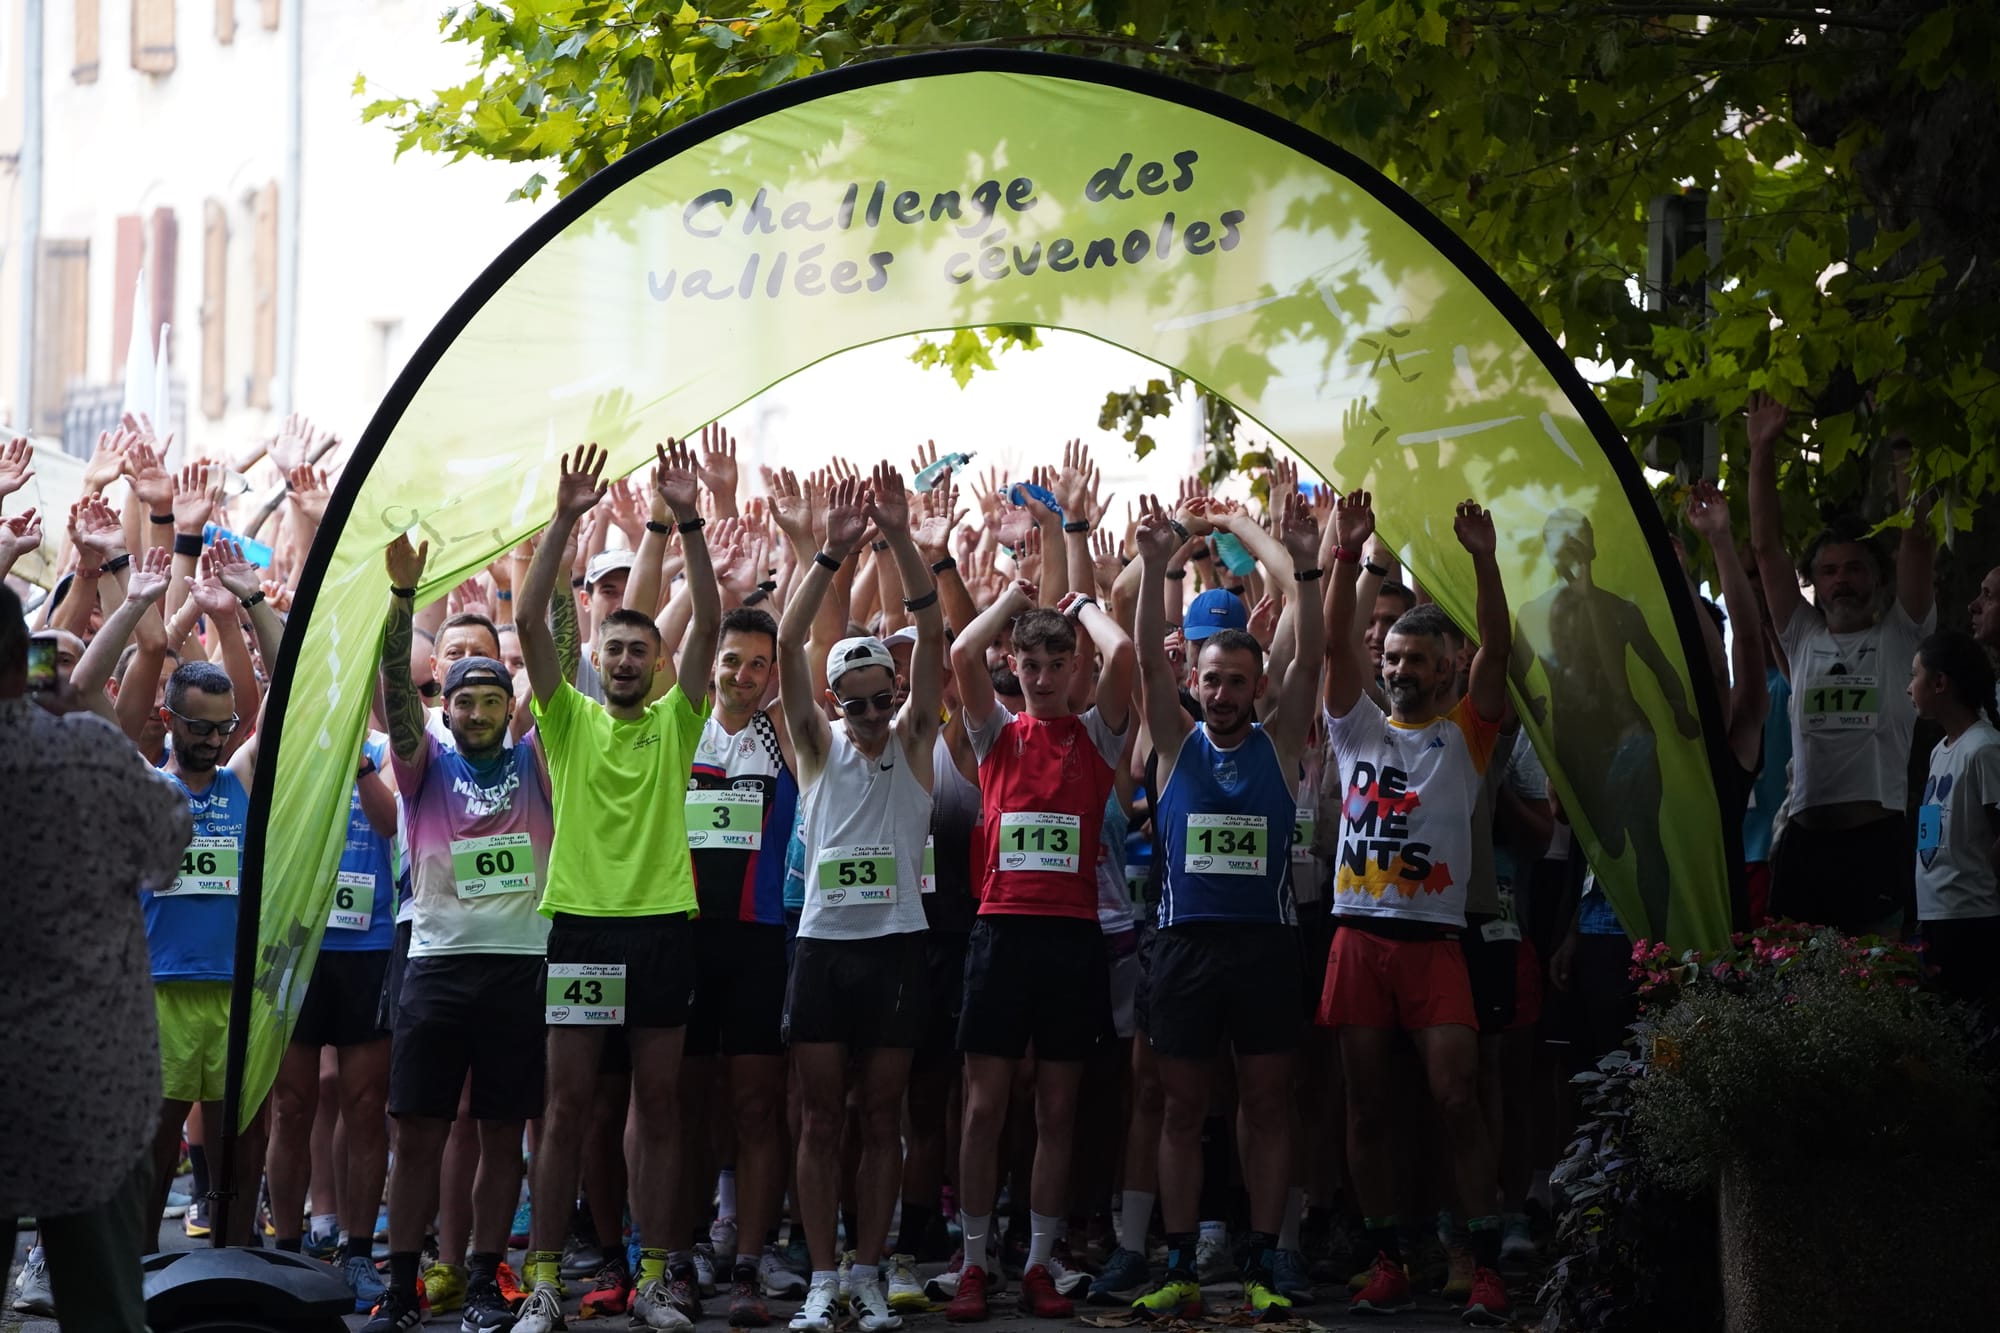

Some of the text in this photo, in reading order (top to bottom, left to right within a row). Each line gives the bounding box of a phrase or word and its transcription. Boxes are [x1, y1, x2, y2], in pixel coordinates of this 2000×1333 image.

[682, 149, 1199, 237] Challenge des
[647, 208, 1246, 302] vallées cévenoles
[1814, 689, 1866, 711] 117
[1350, 761, 1408, 798] DE
[712, 806, 730, 829] 3
[1346, 801, 1409, 839] ME
[1012, 827, 1068, 852] 113
[1199, 829, 1256, 854] 134
[1920, 822, 1928, 839] 5
[180, 852, 216, 875] 46
[476, 850, 514, 876] 60
[1339, 840, 1432, 880] NTS
[838, 861, 877, 885] 53
[564, 980, 603, 1004] 43
